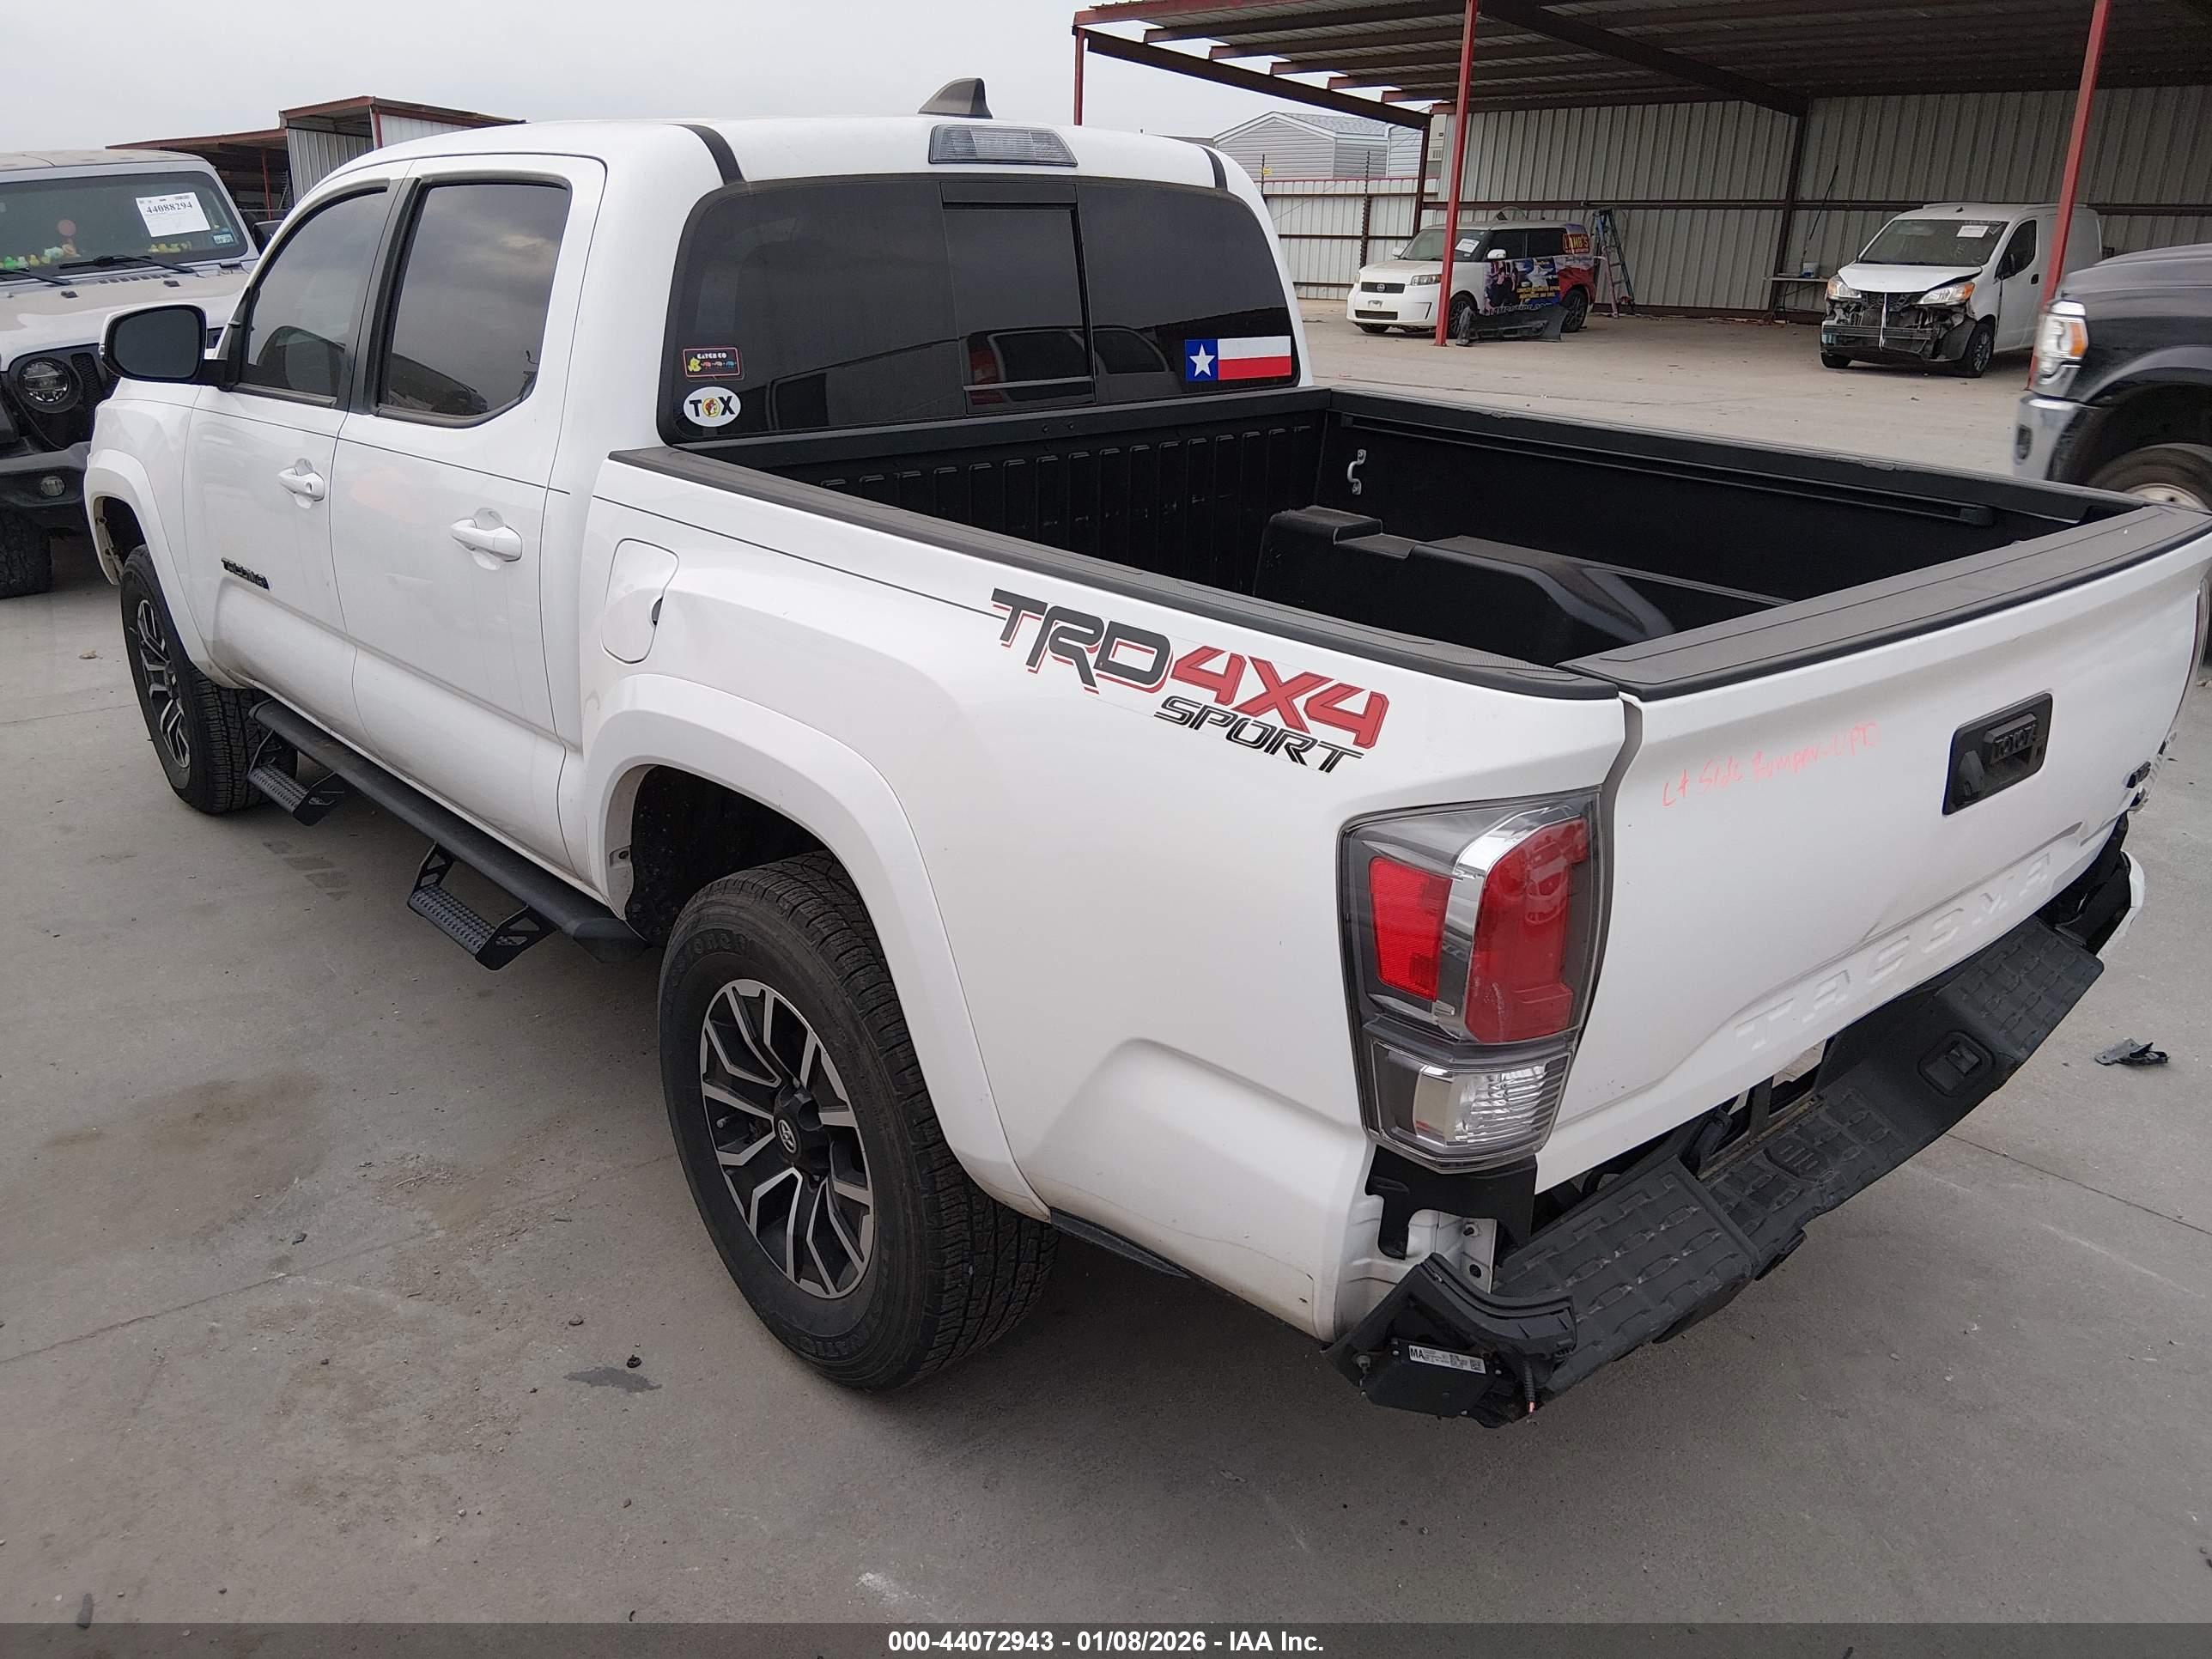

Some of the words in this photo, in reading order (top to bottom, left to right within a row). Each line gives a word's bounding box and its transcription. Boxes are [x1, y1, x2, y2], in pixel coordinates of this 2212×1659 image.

[146, 201, 193, 214] 44088294
[991, 587, 1174, 696] TRD
[1154, 695, 1364, 774] SPORT
[1410, 1347, 1425, 1361] MA
